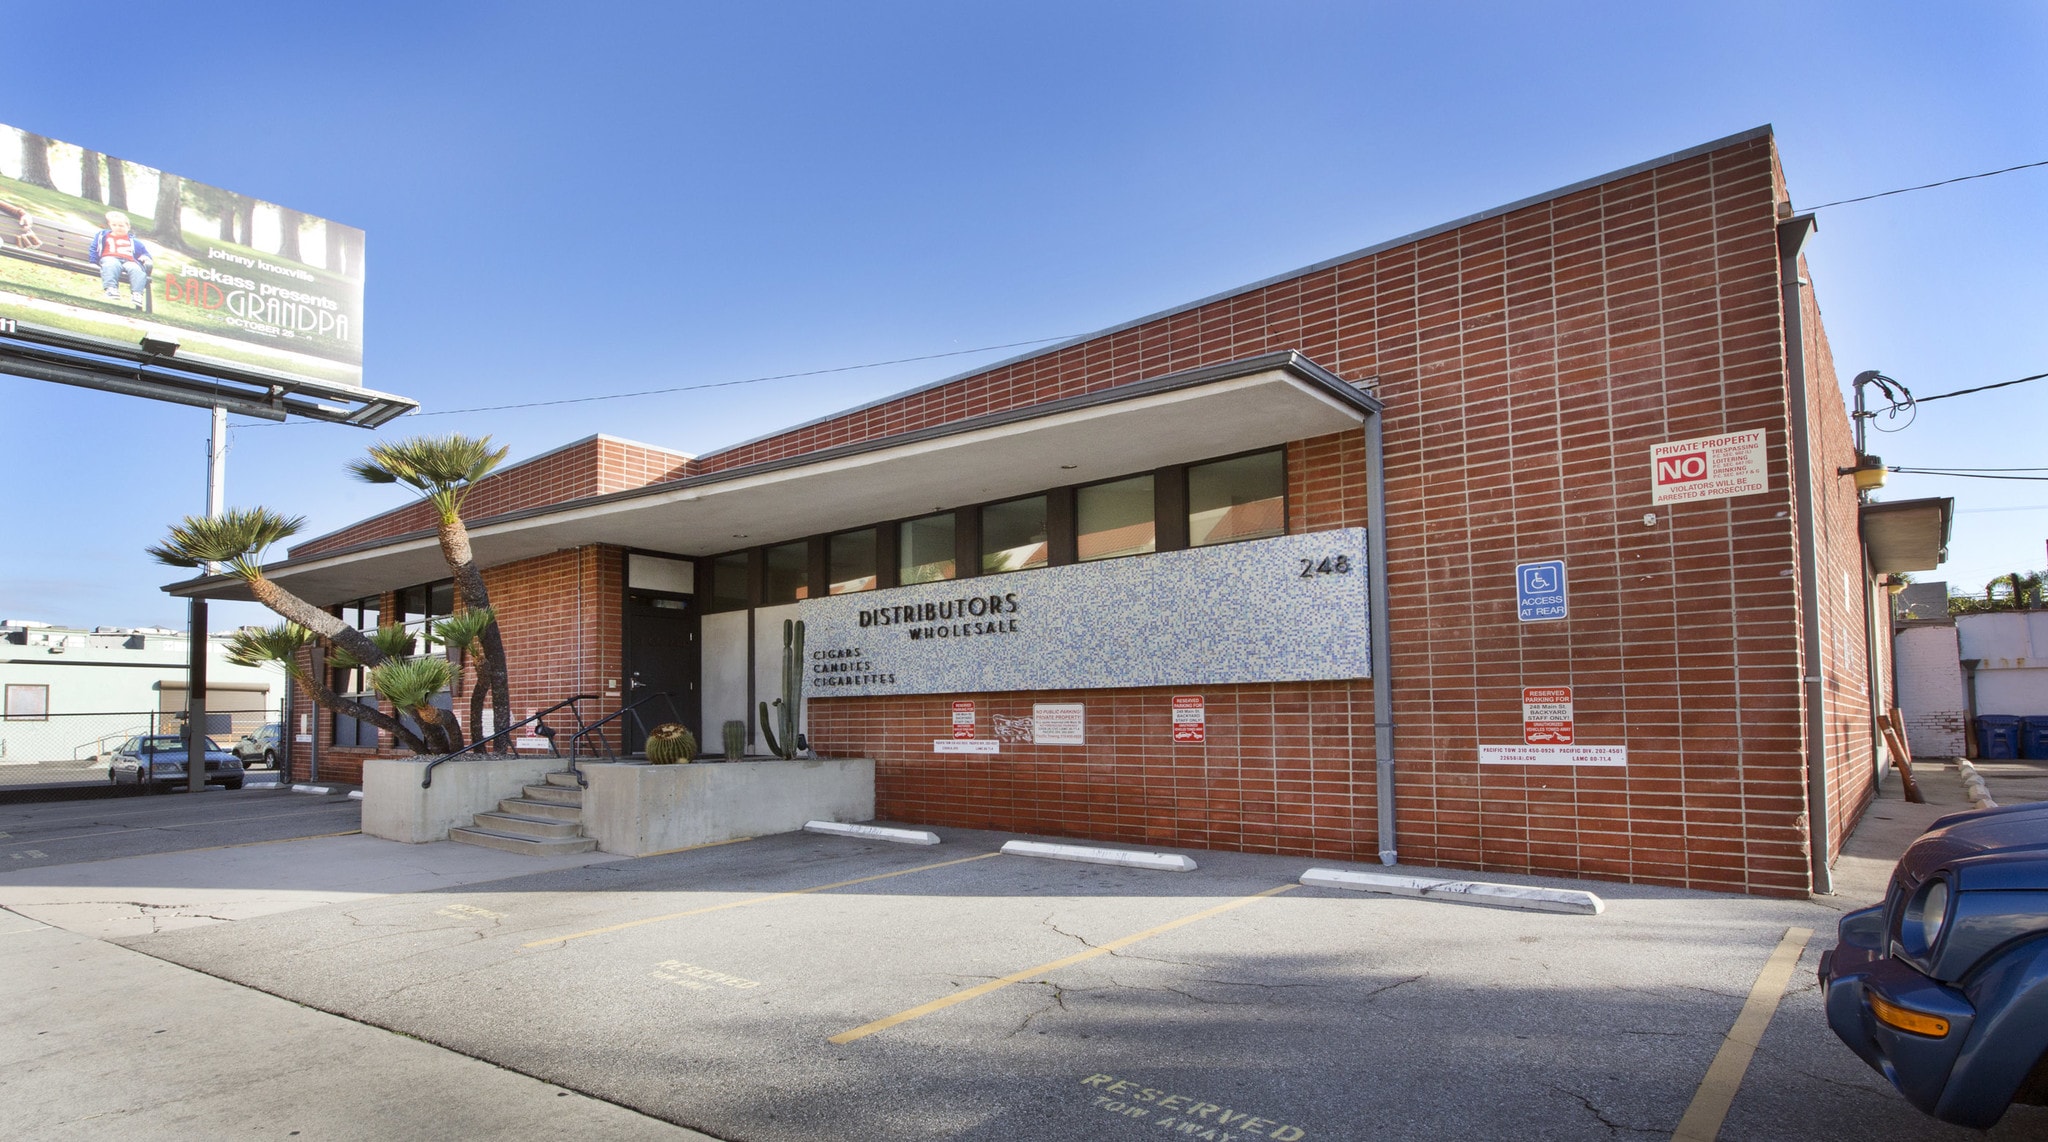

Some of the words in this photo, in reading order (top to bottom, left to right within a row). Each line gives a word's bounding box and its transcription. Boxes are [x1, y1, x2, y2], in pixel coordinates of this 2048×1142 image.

[105, 237, 131, 256] 12
[208, 246, 255, 268] johnny
[257, 259, 315, 282] knoxville
[180, 263, 255, 291] jackass
[260, 282, 338, 311] presents
[165, 273, 225, 310] BAD
[226, 290, 349, 341] GRANDPA
[225, 317, 281, 336] OCTOBER
[1655, 442, 1699, 456] PRIVATE
[1701, 433, 1760, 449] PROPERTY
[1712, 443, 1759, 455] TRESPASSING
[1658, 457, 1706, 482] NO
[1712, 455, 1748, 465] LOITERING
[1713, 466, 1747, 475] DRINKING
[1657, 491, 1698, 502] ARRESTED
[1707, 483, 1762, 496] PROSECUTED
[1670, 482, 1714, 493] VIOLATORS
[1715, 480, 1735, 488] WILL
[1299, 554, 1348, 578] 248
[859, 593, 1018, 628] DISTRIBUTORS
[1521, 596, 1563, 606] ACCESS
[1521, 608, 1533, 616] AT
[1536, 606, 1564, 615] REAR
[909, 619, 1018, 640] WHOLESALE
[813, 648, 861, 661] CIGARS
[813, 661, 871, 674] CANDIES
[813, 674, 895, 687] CIGARETTES
[1080, 1073, 1306, 1142] RESERVED
[1093, 1096, 1150, 1118] TOW
[1155, 1117, 1238, 1142] AWAY
